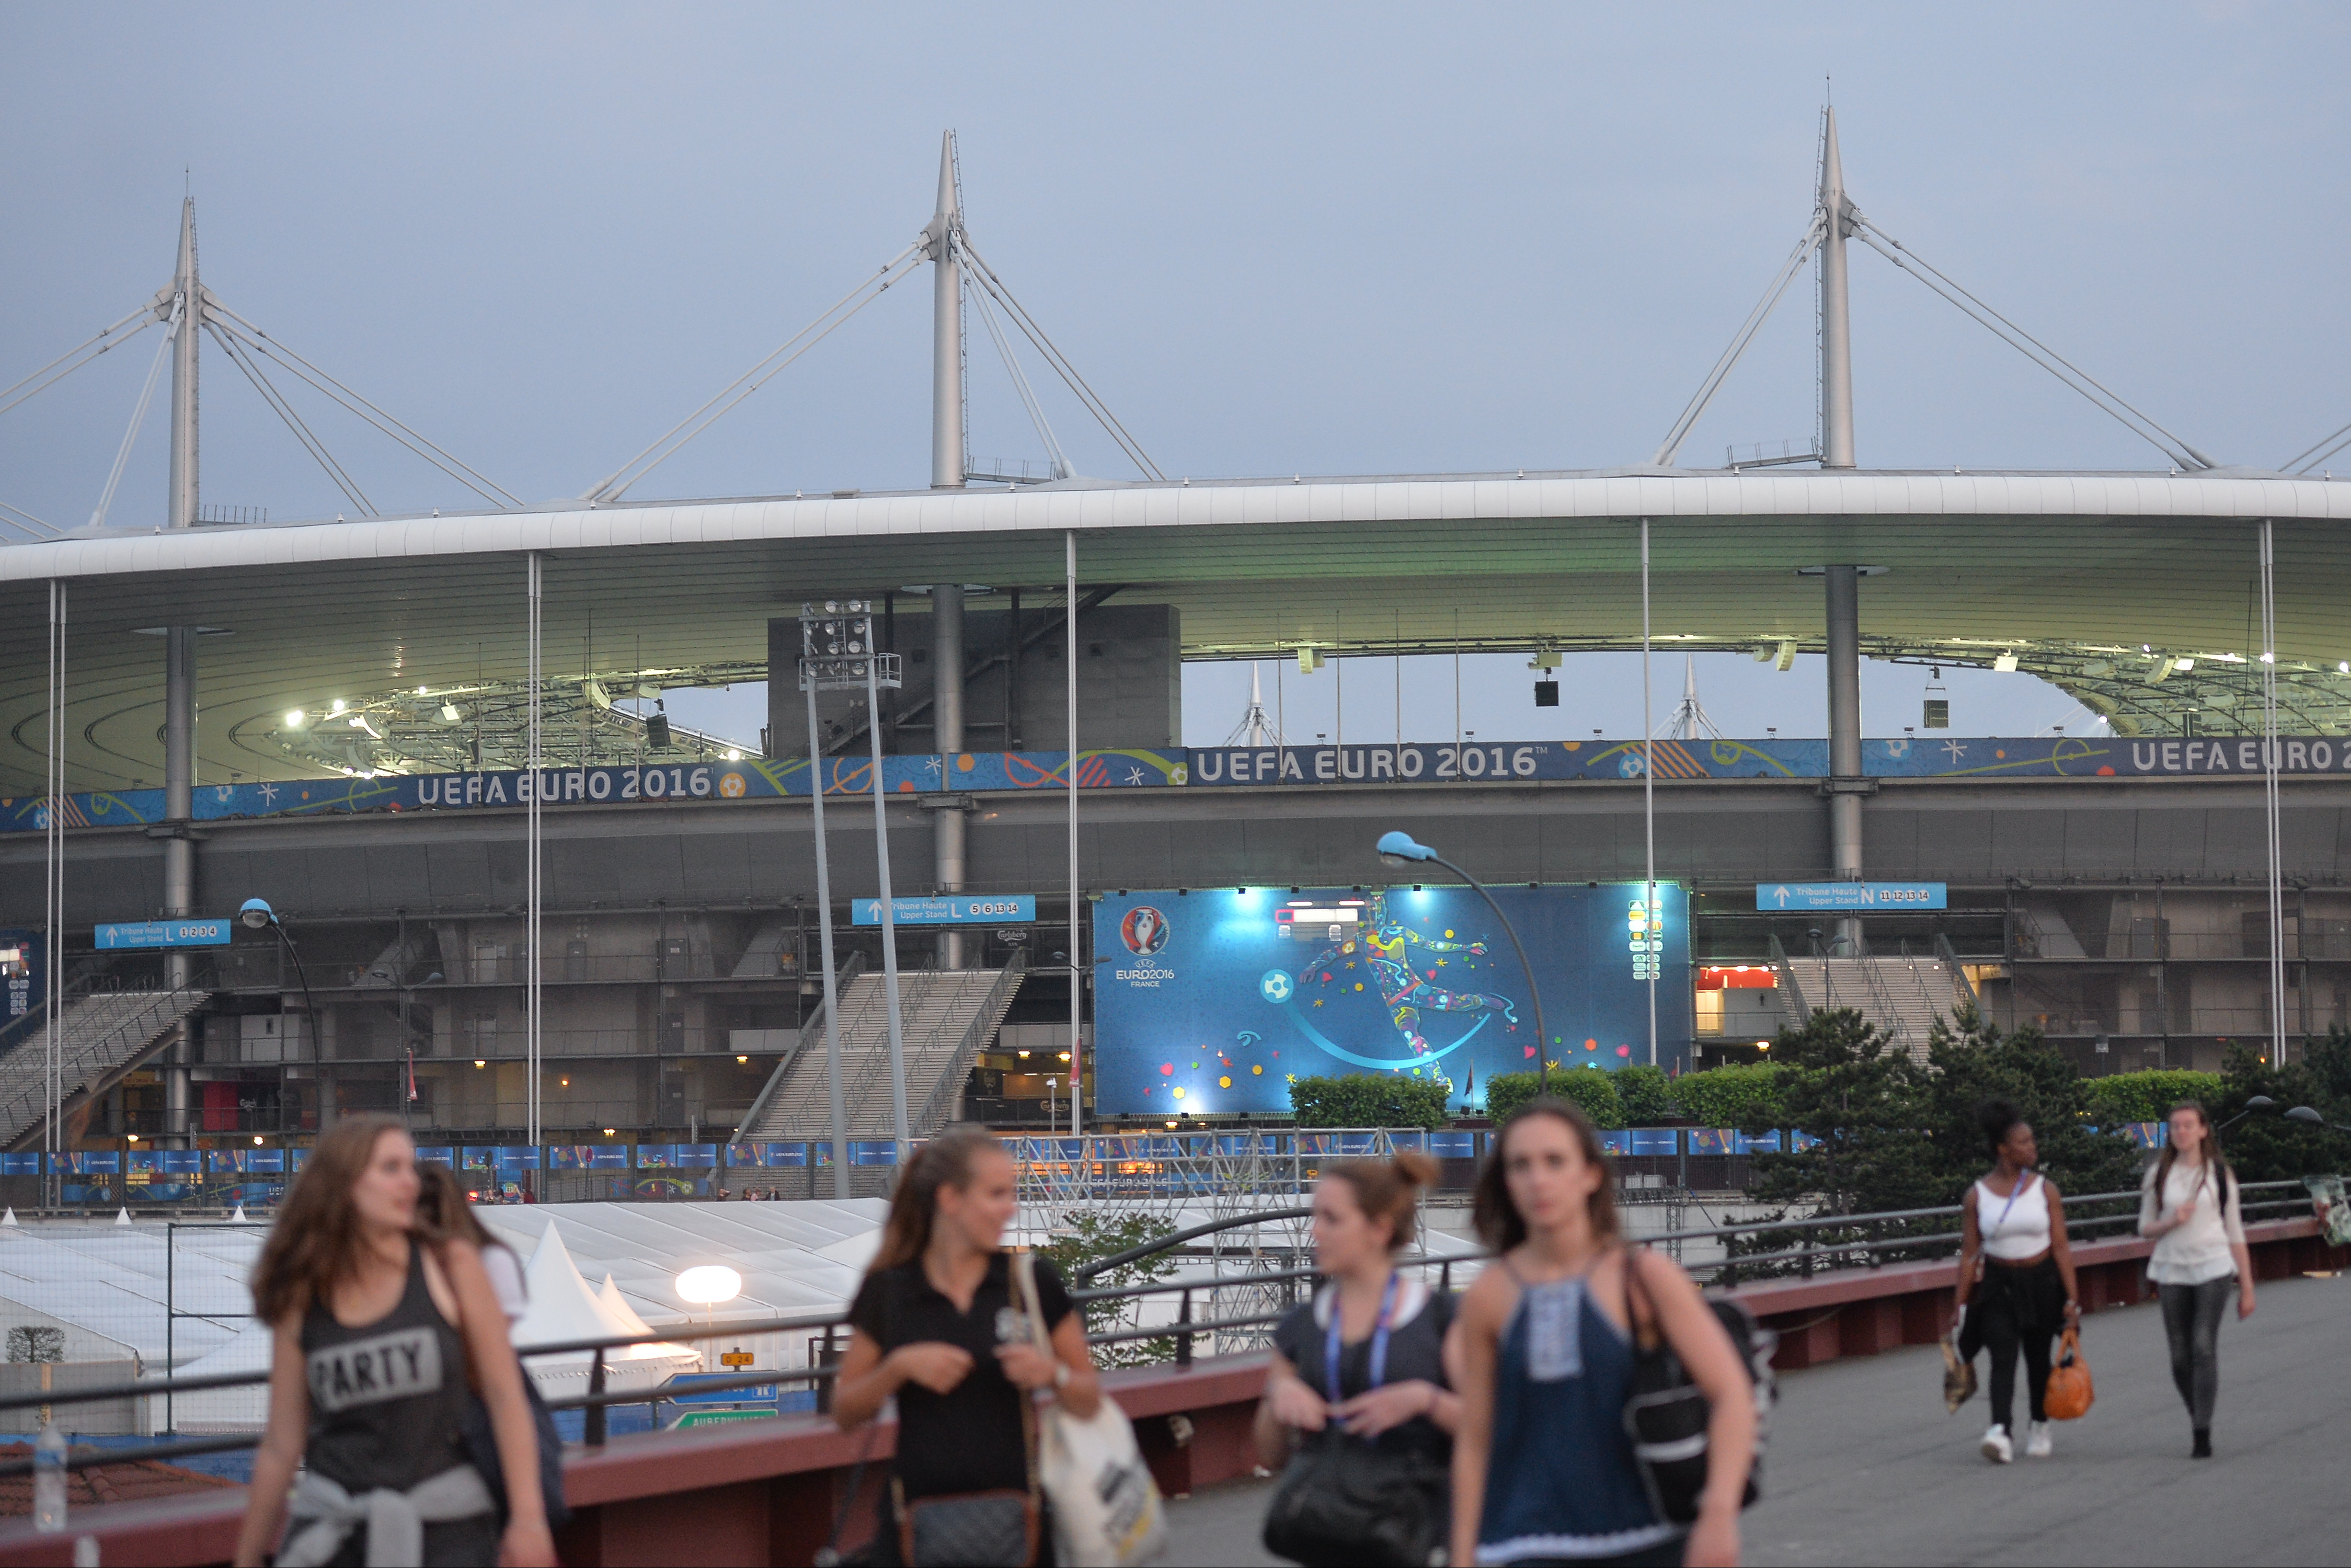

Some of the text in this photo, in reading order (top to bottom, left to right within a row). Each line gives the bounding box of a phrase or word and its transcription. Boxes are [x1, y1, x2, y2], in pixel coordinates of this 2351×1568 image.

[2132, 741, 2229, 770] UEFA
[2238, 740, 2332, 770] EURO
[1197, 751, 1304, 781] UEFA
[1315, 748, 1424, 779] EURO
[418, 775, 507, 804] UEFA
[516, 770, 612, 801] EURO
[1809, 897, 1833, 905] Upper
[1861, 889, 1874, 904] N
[900, 911, 924, 920] Upper
[951, 903, 962, 918] L
[165, 928, 174, 942] L
[997, 930, 1027, 941] Carlsberg
[1136, 959, 1155, 968] UEFA
[1116, 969, 1175, 980] EURO2016
